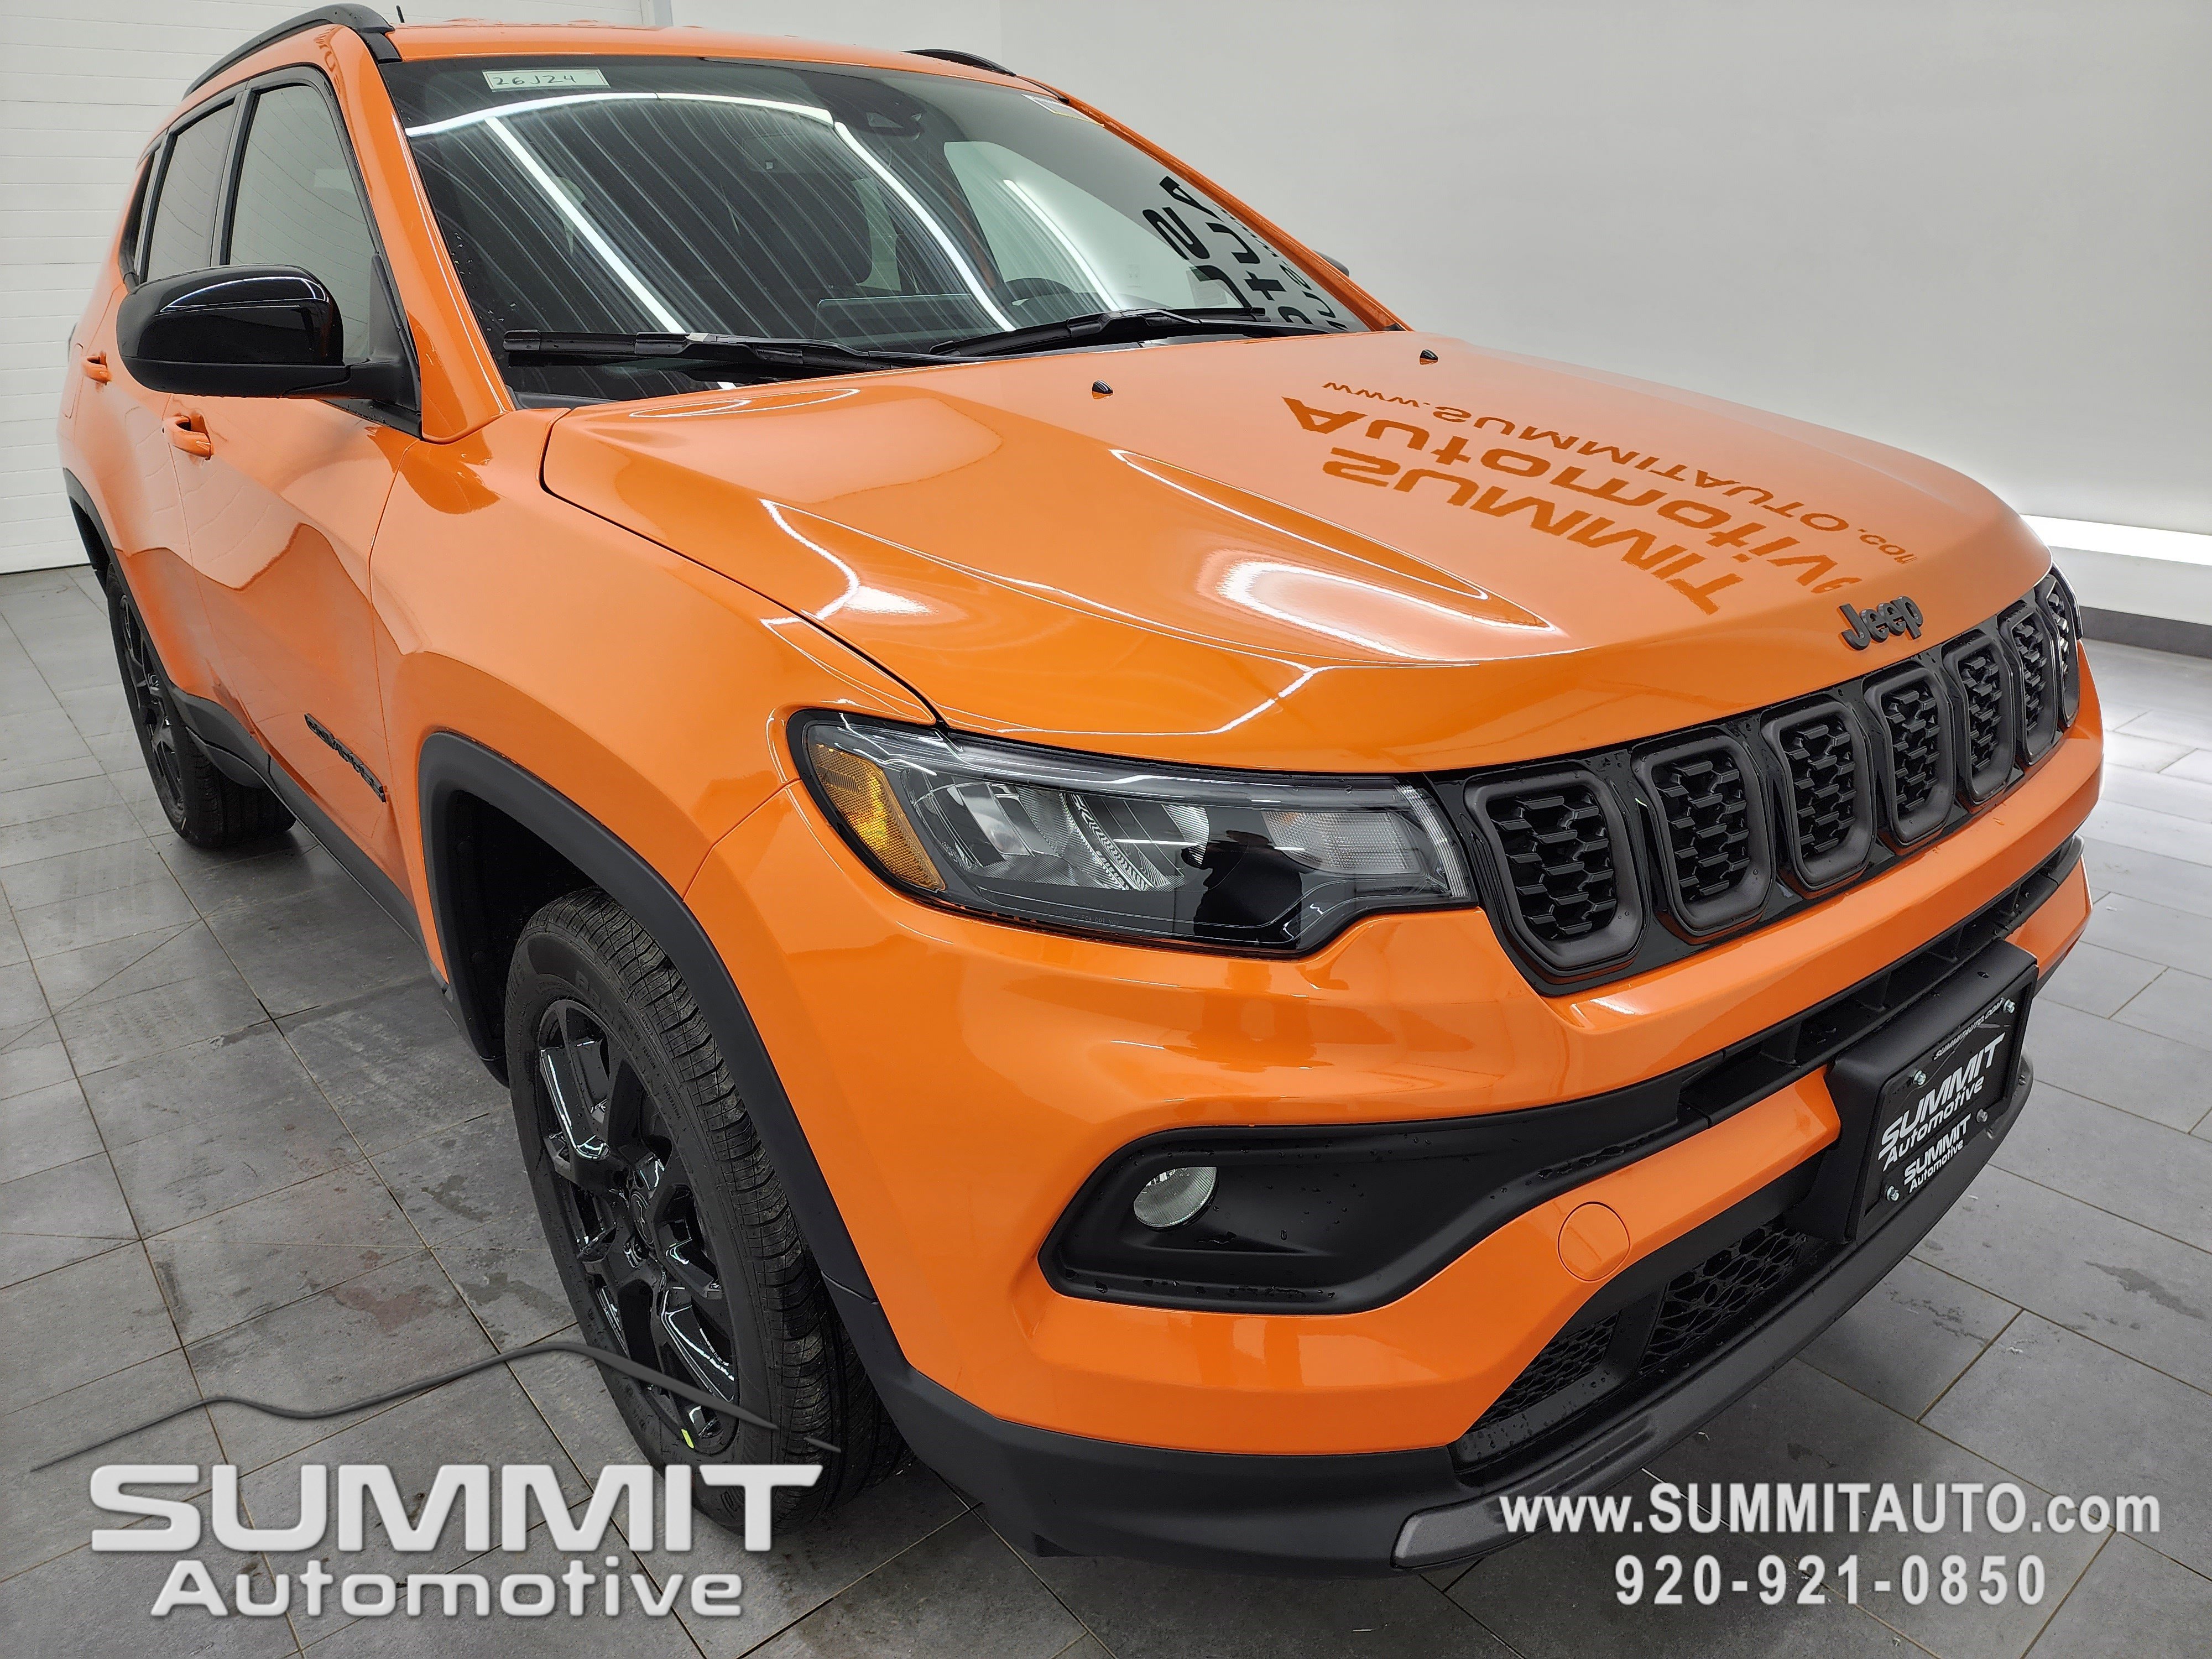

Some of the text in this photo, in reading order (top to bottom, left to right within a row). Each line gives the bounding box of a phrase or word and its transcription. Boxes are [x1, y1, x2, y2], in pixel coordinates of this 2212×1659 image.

[492, 75, 577, 85] 26J24
[1838, 596, 1924, 650] Jeep
[1878, 1032, 2006, 1161] SUMMIT
[1882, 1076, 1984, 1172] Automotive
[1904, 1113, 1971, 1186] SUMMIT
[1909, 1139, 1963, 1193] Automotive
